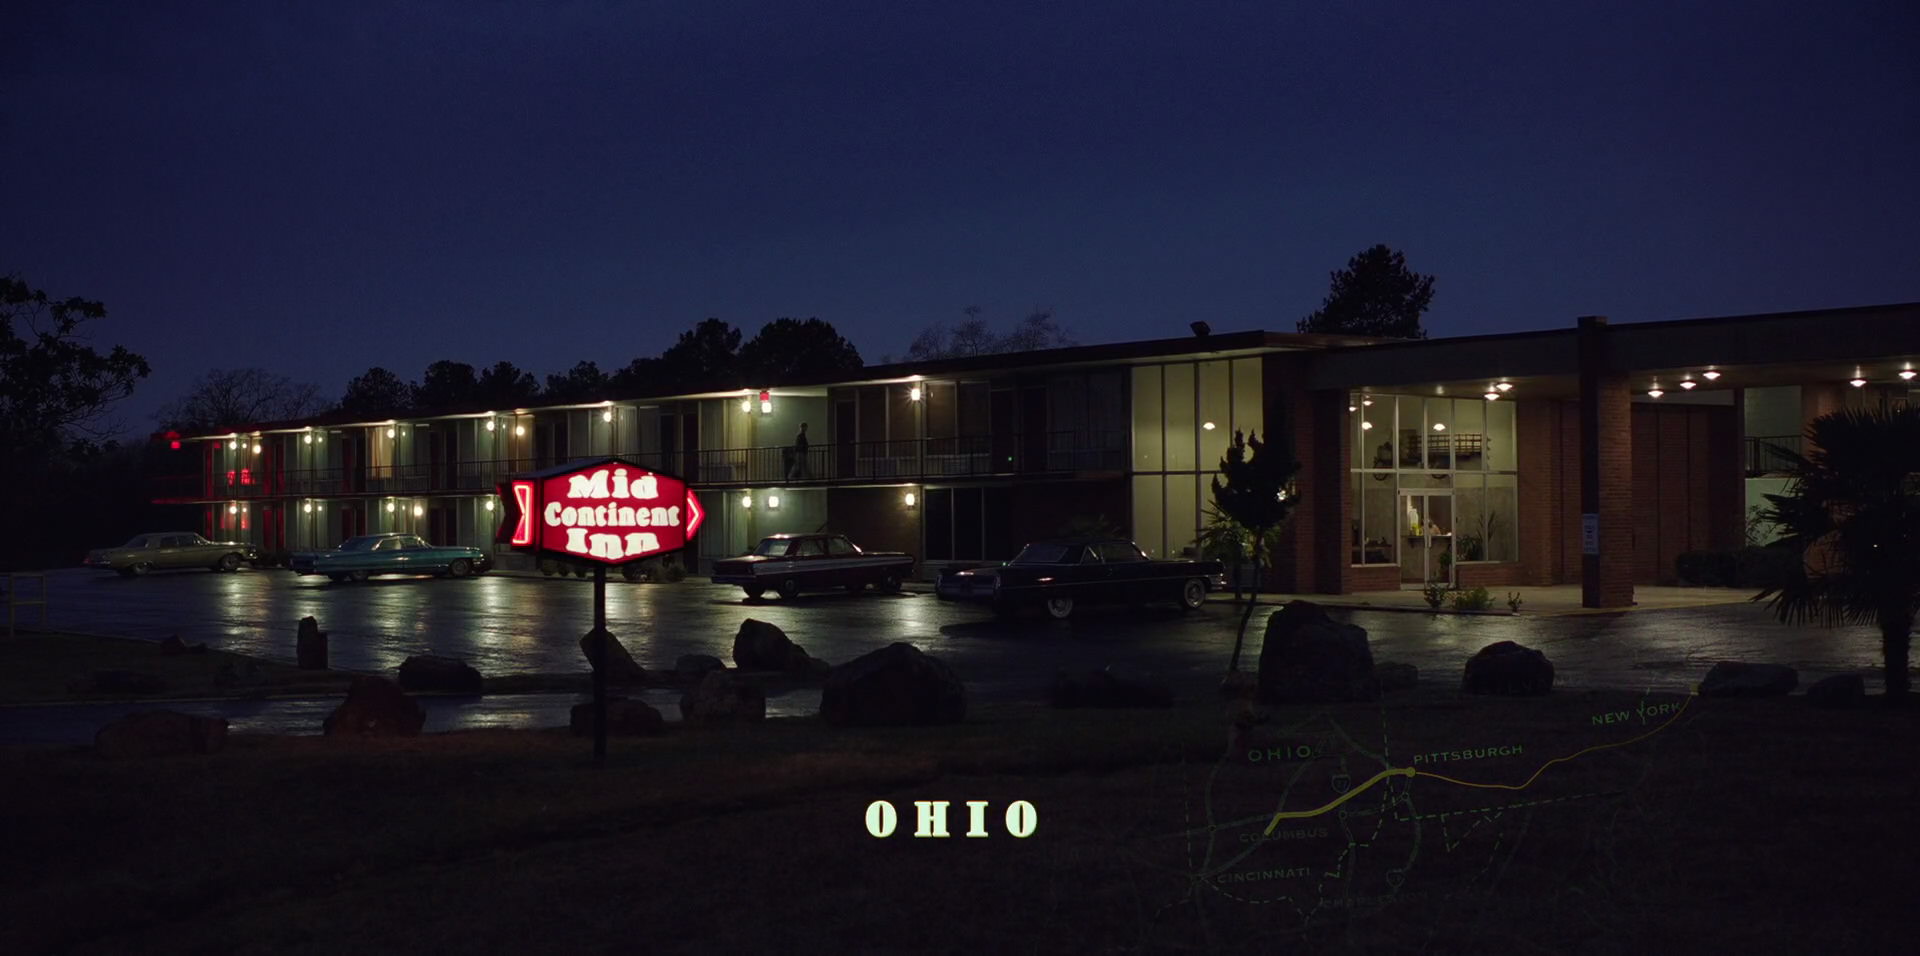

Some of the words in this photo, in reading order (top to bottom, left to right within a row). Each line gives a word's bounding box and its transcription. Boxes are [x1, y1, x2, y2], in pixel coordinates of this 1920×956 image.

[567, 468, 658, 499] Mid
[544, 502, 680, 527] Continent
[566, 528, 660, 559] Inn
